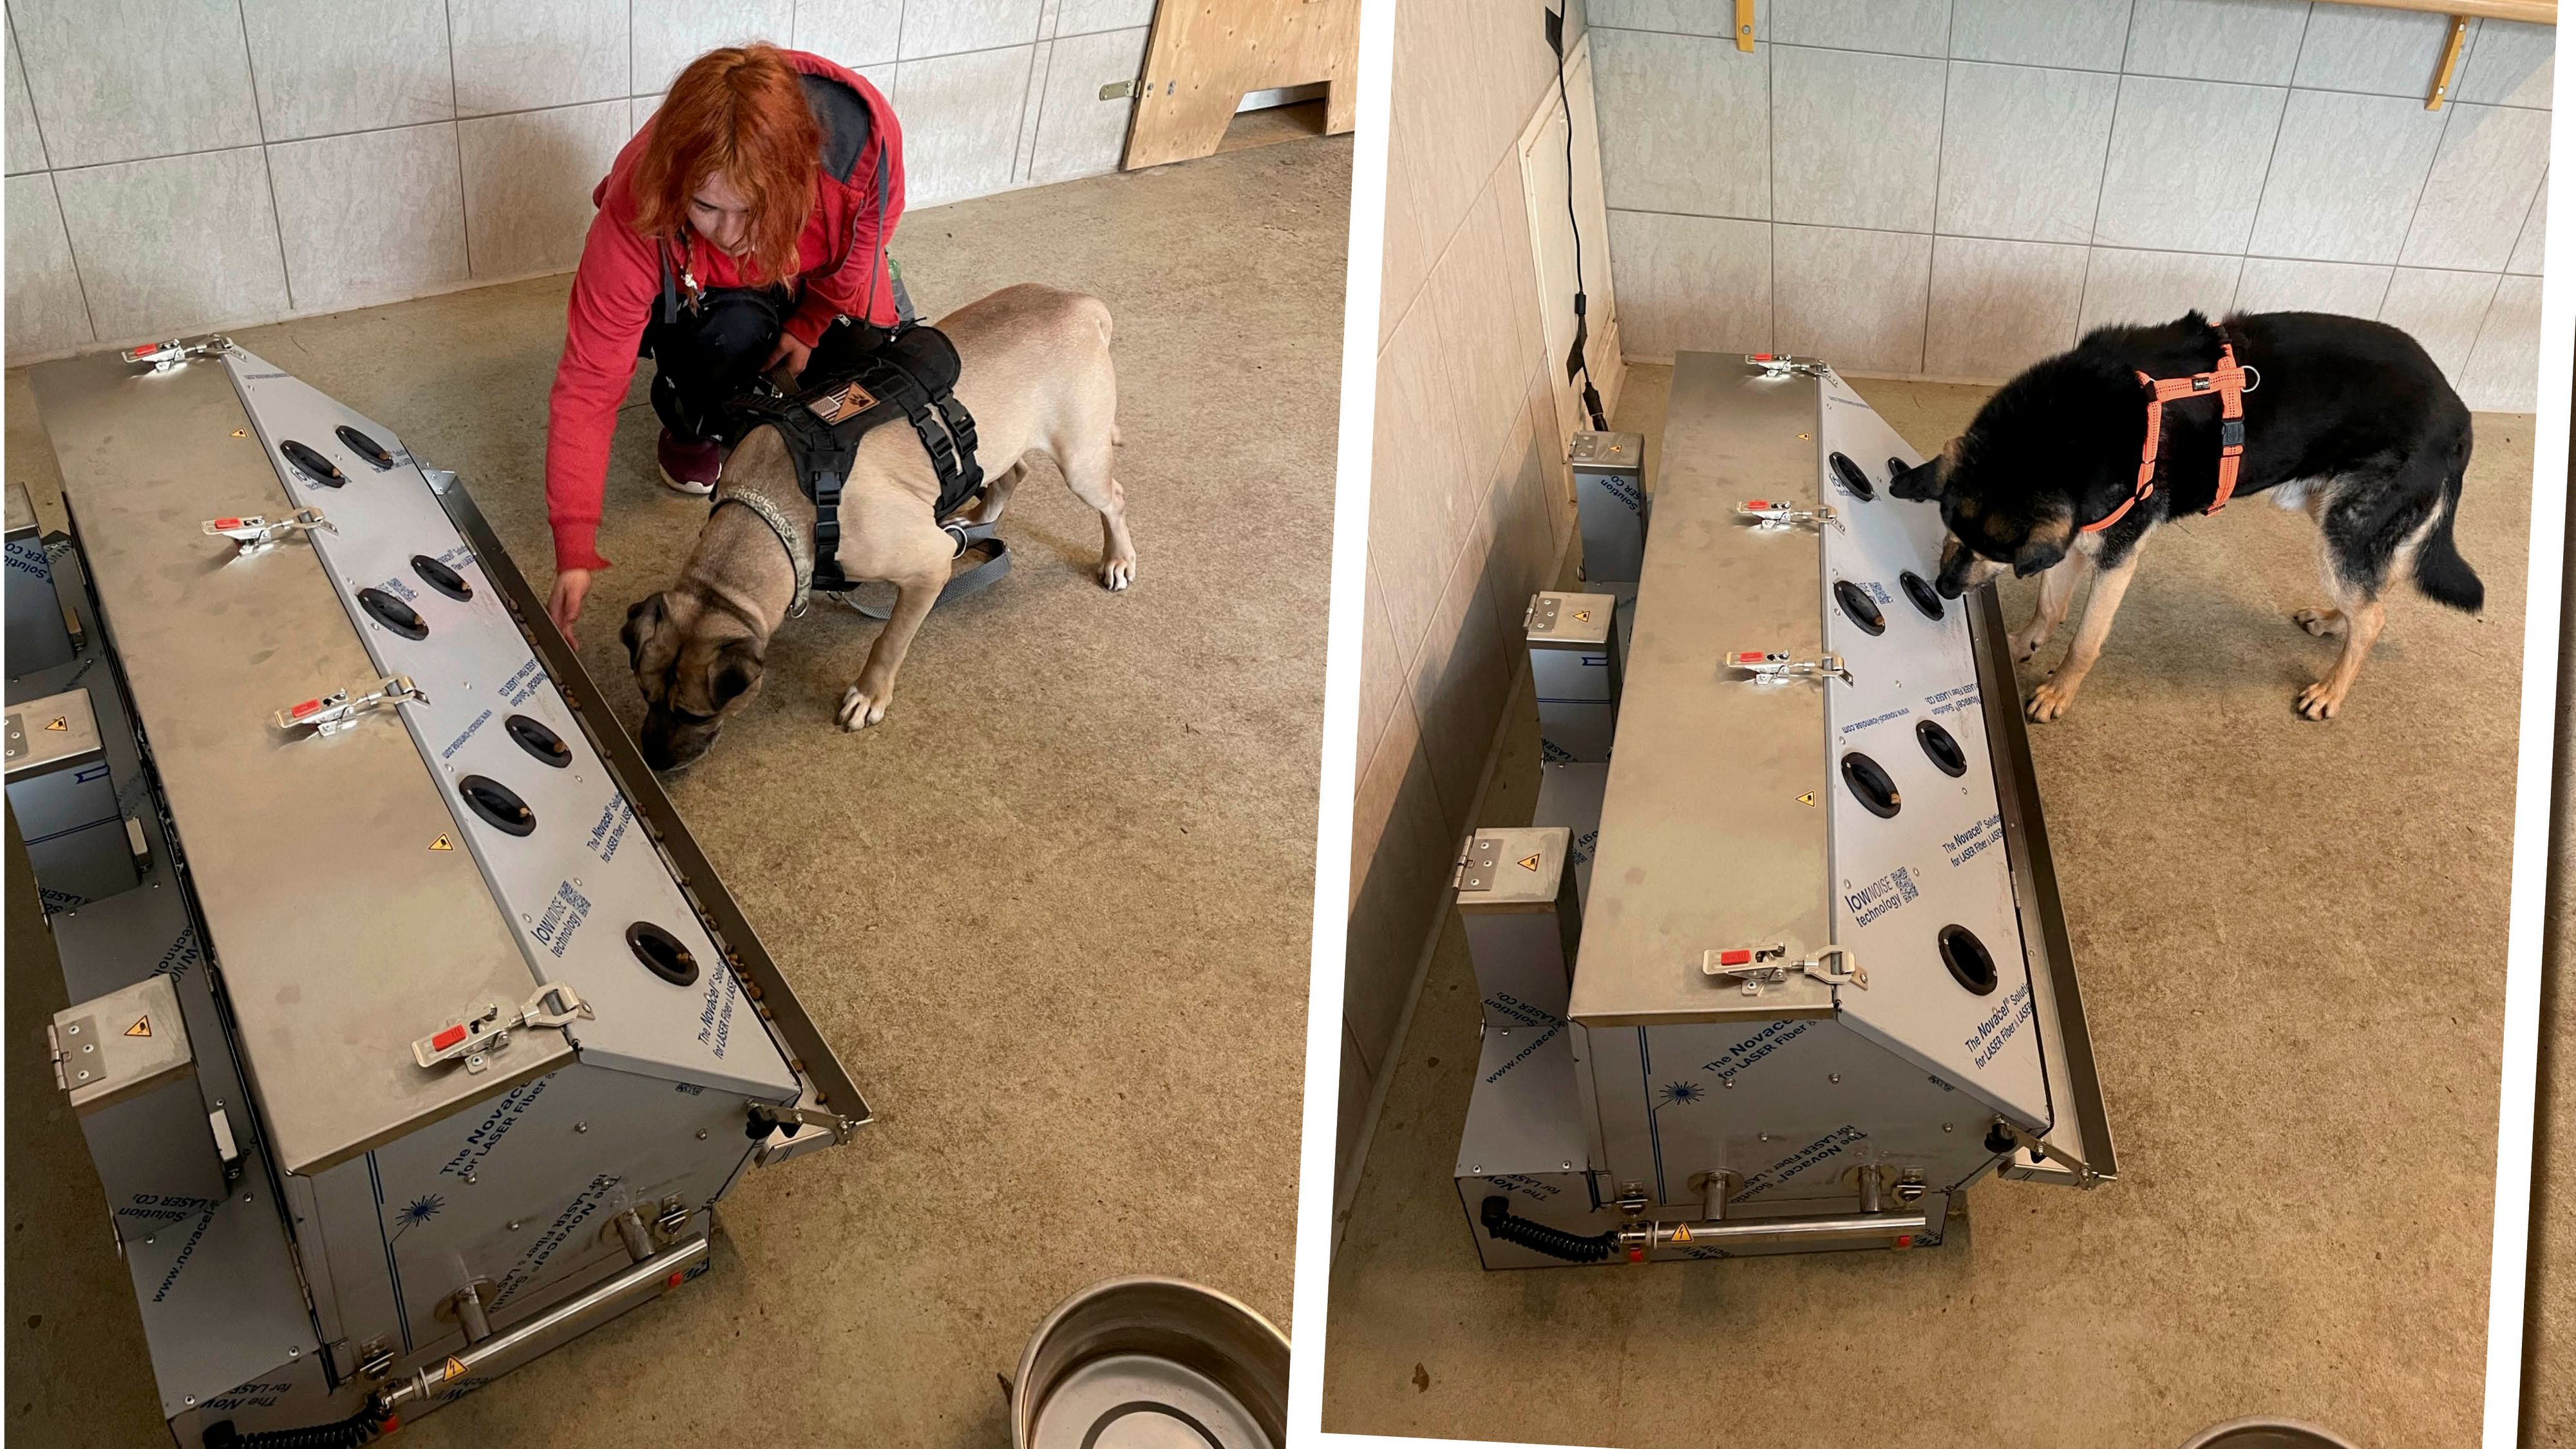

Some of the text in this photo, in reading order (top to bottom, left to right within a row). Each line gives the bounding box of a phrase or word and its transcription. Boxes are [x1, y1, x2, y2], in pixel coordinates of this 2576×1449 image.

[1600, 479, 1638, 510] Solution
[1624, 485, 1641, 500] SER
[1936, 691, 1949, 703] LASER
[1932, 703, 1955, 715] Solution
[587, 838, 600, 851] The
[604, 836, 620, 856] LASER
[1942, 842, 1956, 854] The
[1950, 857, 1961, 867] for
[1958, 846, 1977, 863] LASER
[1974, 840, 1988, 853] Fiber
[1855, 893, 1902, 928] technology
[550, 910, 582, 958] technology
[721, 1002, 732, 1023] Fiber
[1484, 999, 1539, 1027] Solution
[1518, 1003, 1557, 1023] LASER
[697, 1027, 711, 1046] The
[715, 1019, 730, 1048] LASER
[713, 1045, 724, 1060] for
[1717, 1067, 1738, 1080] for
[1736, 1043, 1777, 1069] LASER
[1774, 1024, 1807, 1045] Fiber
[1965, 1035, 1982, 1053] The
[1975, 1055, 1987, 1070] for
[1983, 1036, 2004, 1061] LASER
[2000, 1022, 2016, 1042] Fiber
[1701, 1056, 1732, 1072] The
[457, 1159, 478, 1177] for
[475, 1117, 518, 1157] LASER
[513, 1081, 546, 1113] Fiber
[1799, 1133, 1837, 1155] LASER
[440, 1149, 471, 1175] The
[1772, 1153, 1803, 1171] Fiber
[1522, 1188, 1548, 1202] The
[1541, 1185, 1562, 1195] for
[162, 1195, 209, 1209] LASER
[553, 1192, 591, 1228] LASER
[118, 1207, 187, 1222] Solution
[526, 1230, 556, 1258] Fiber
[269, 1383, 293, 1393] for
[247, 1396, 278, 1406] The
